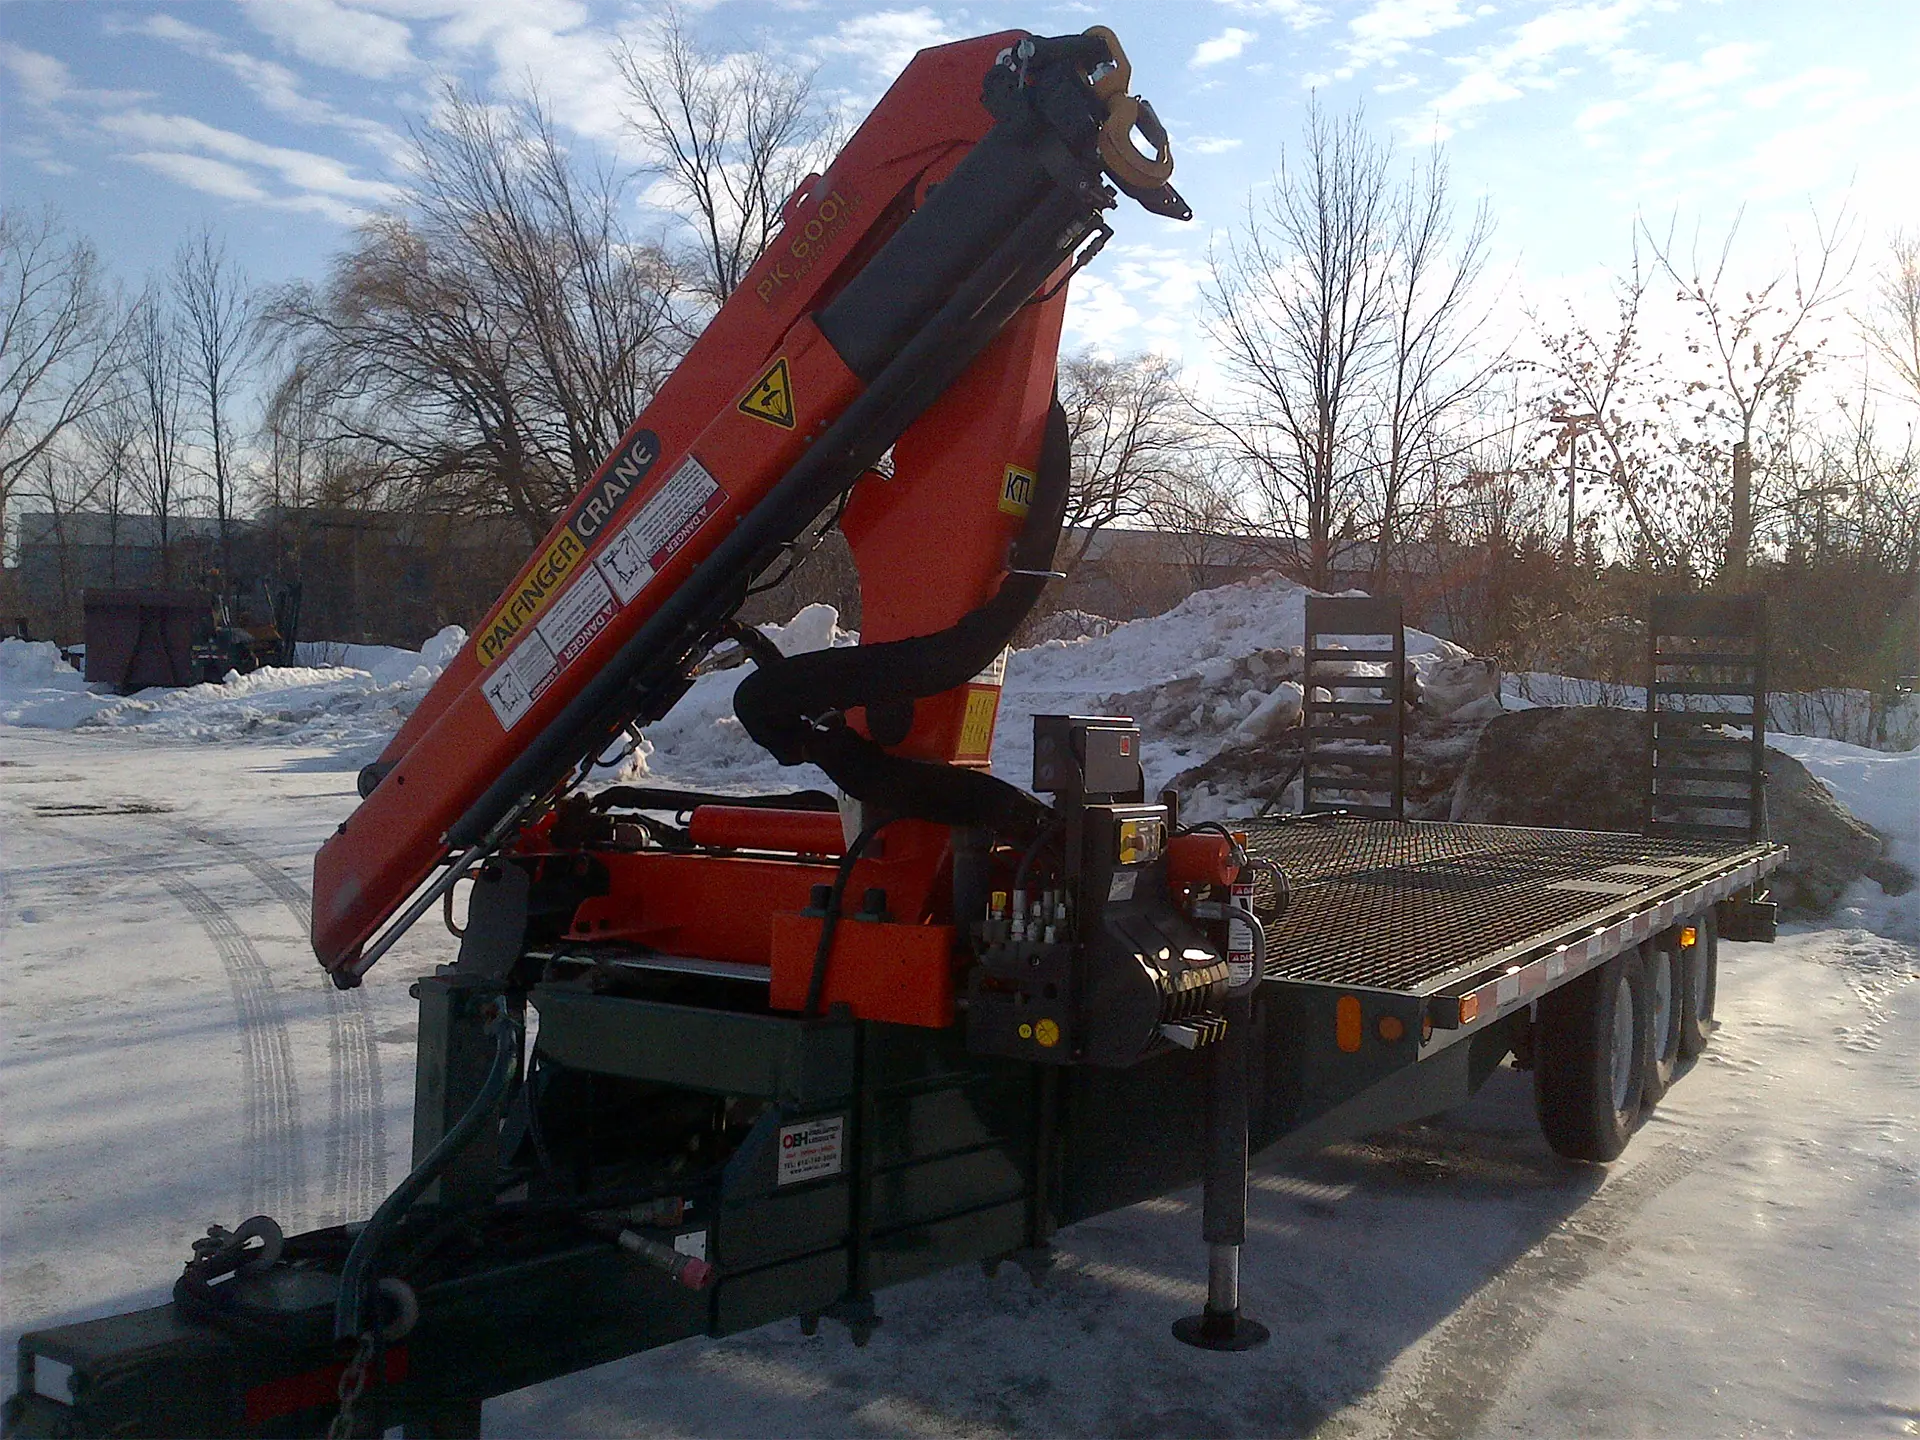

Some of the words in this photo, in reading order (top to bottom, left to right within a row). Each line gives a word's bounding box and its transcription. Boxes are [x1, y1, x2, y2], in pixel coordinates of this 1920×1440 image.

[756, 260, 790, 303] PK
[791, 191, 846, 258] 6001
[481, 535, 580, 660] PALFINGER
[576, 440, 652, 537] CRANE
[664, 513, 701, 553] DANGER
[562, 612, 605, 661] DANGER
[530, 671, 554, 700] DANGER
[783, 1131, 808, 1149] OEH
